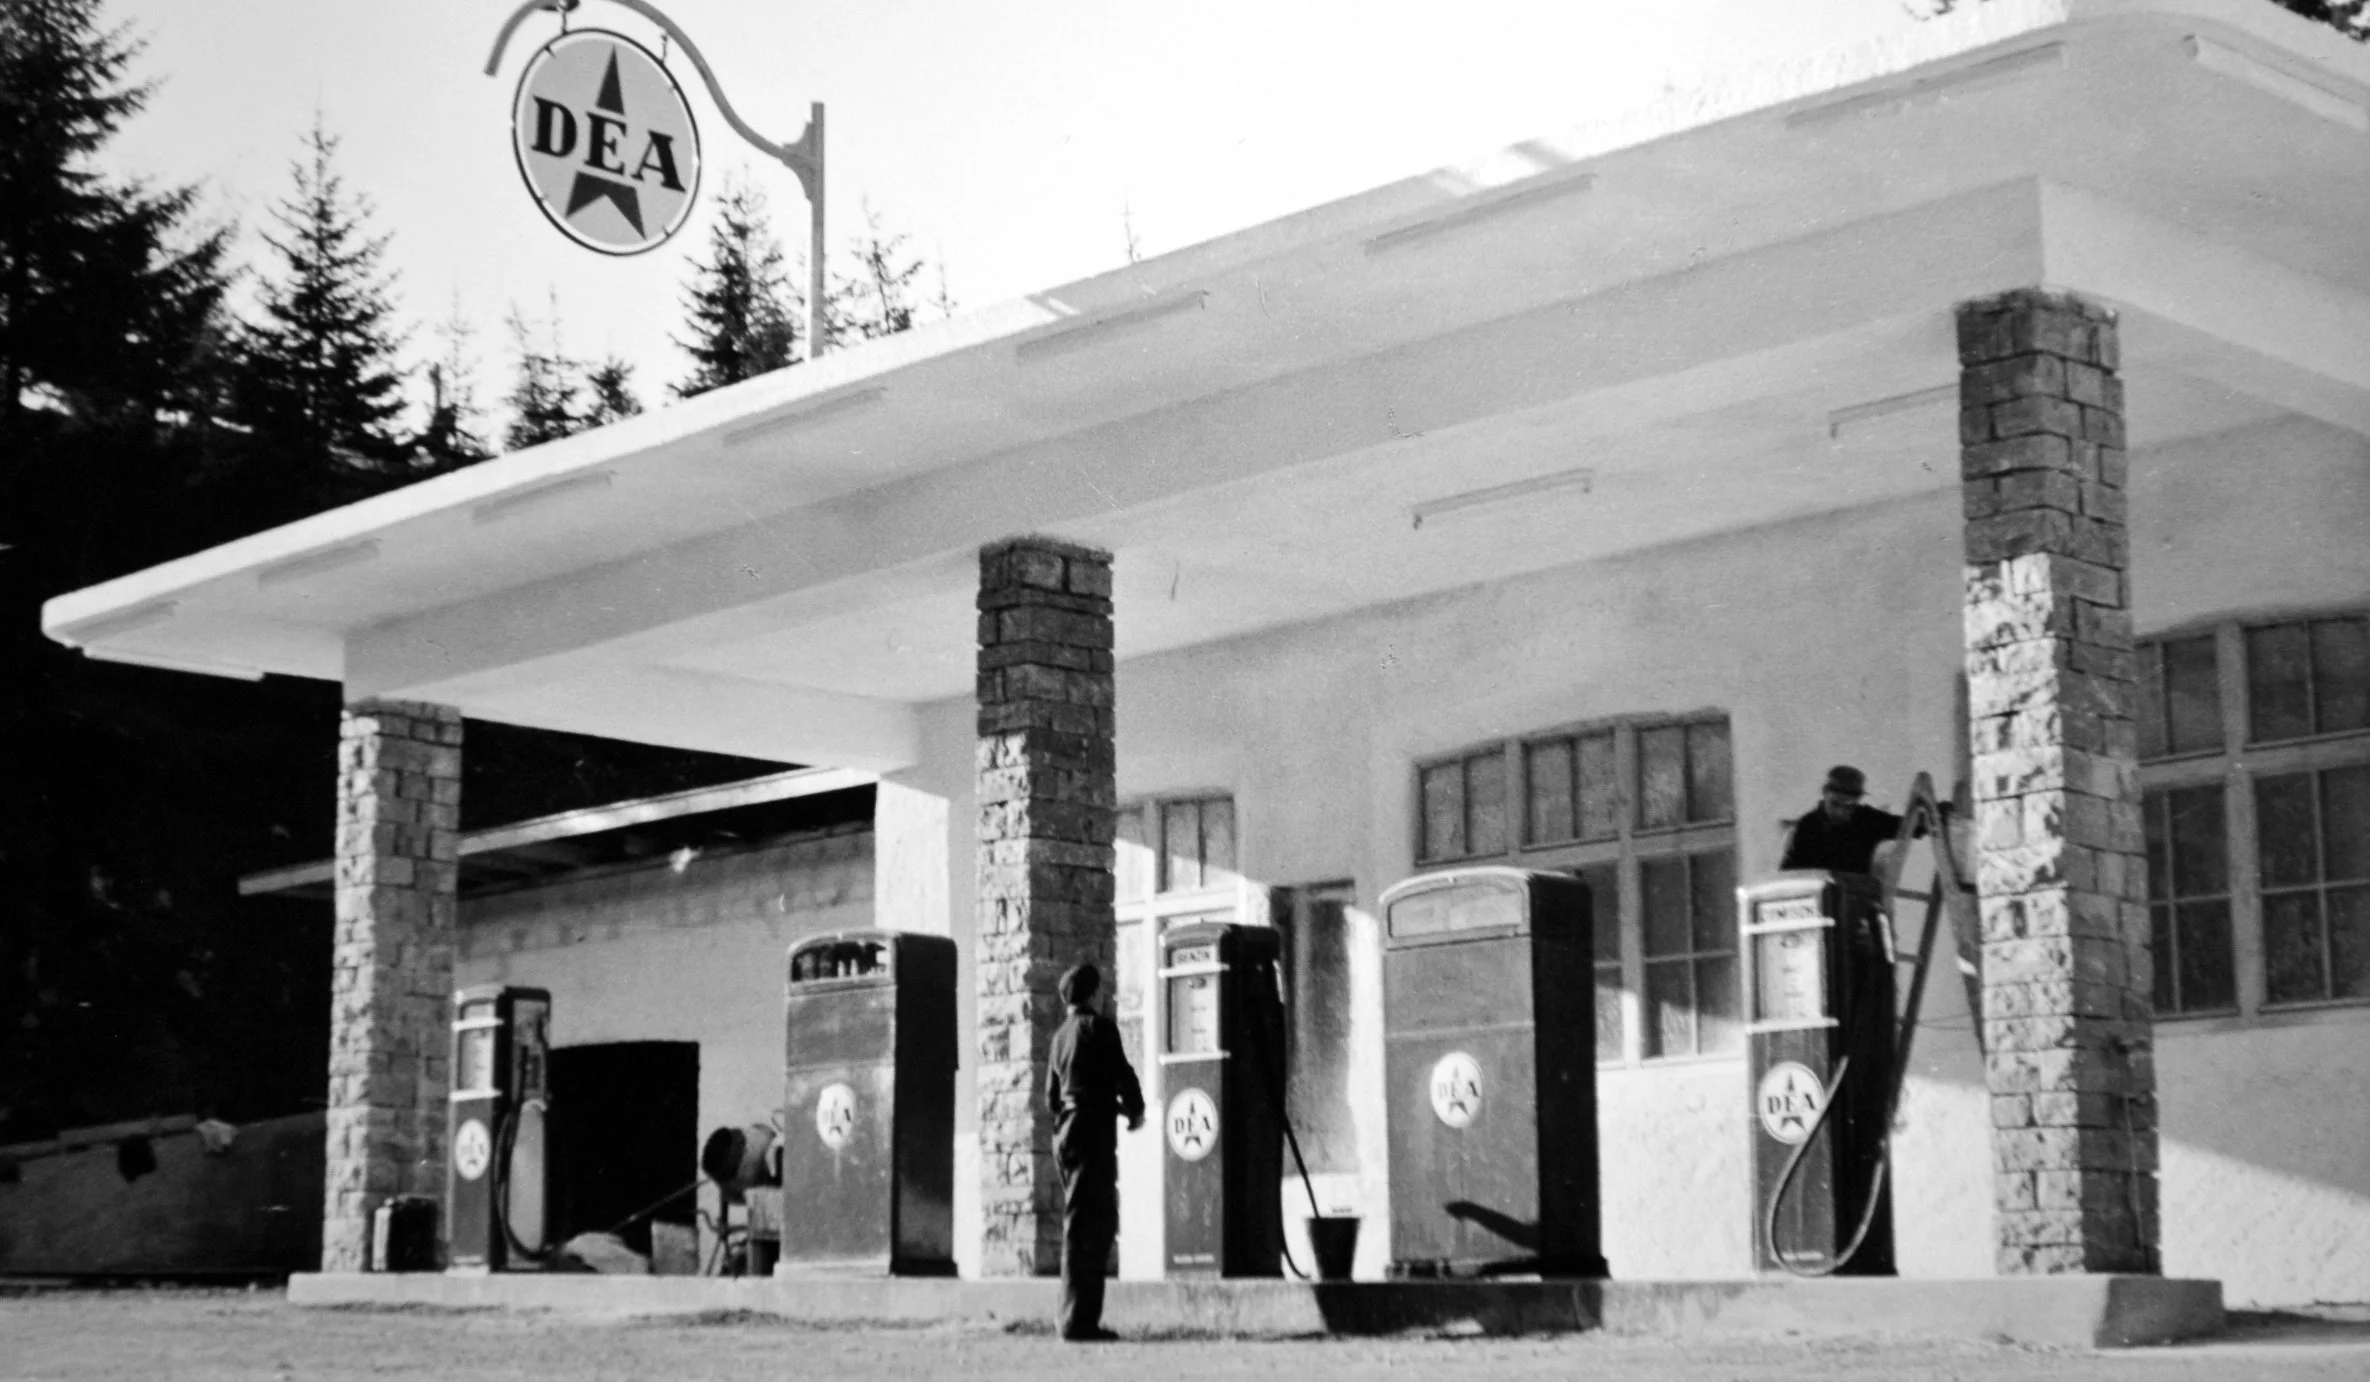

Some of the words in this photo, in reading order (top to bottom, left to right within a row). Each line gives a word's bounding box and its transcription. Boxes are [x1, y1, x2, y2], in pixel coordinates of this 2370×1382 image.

[531, 94, 687, 194] DEA
[1437, 1080, 1480, 1099] DEA
[1767, 1092, 1816, 1115] DEA
[1174, 1115, 1212, 1135] DEA
